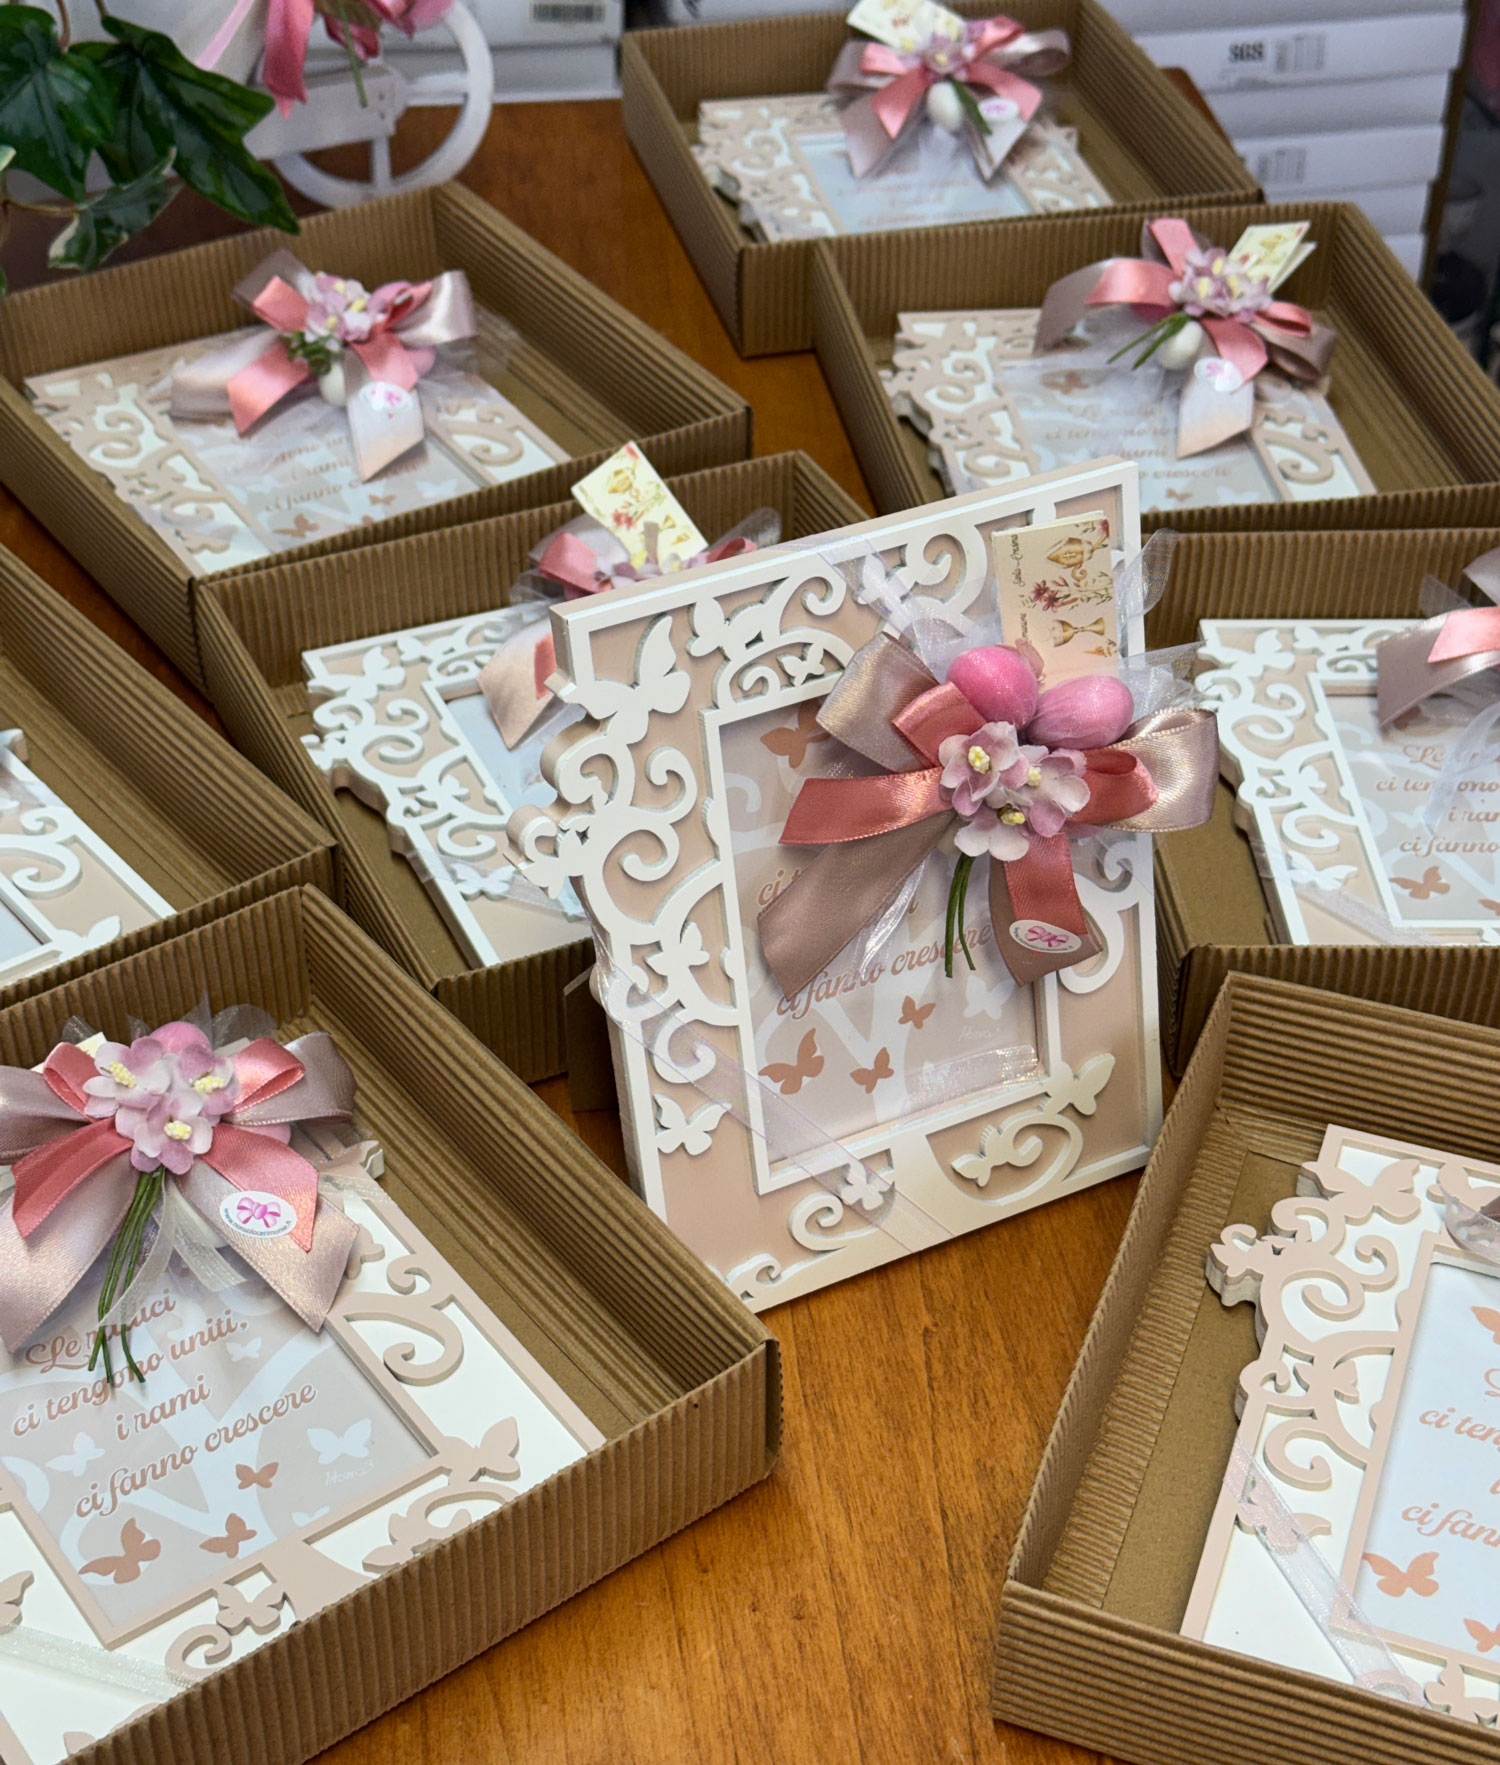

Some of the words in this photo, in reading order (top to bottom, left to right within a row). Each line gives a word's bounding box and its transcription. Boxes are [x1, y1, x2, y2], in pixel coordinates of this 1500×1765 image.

[1228, 41, 1264, 62] SGS
[13, 1403, 41, 1437] ci
[170, 1308, 249, 1361] uniti,
[25, 1335, 91, 1374] Le
[115, 1413, 130, 1441] i
[134, 1374, 211, 1434] rami
[1418, 1406, 1457, 1429] ci
[76, 1482, 105, 1518] ci
[98, 1444, 199, 1517] fanno
[204, 1383, 317, 1453] crescere
[1401, 1502, 1440, 1526] ci
